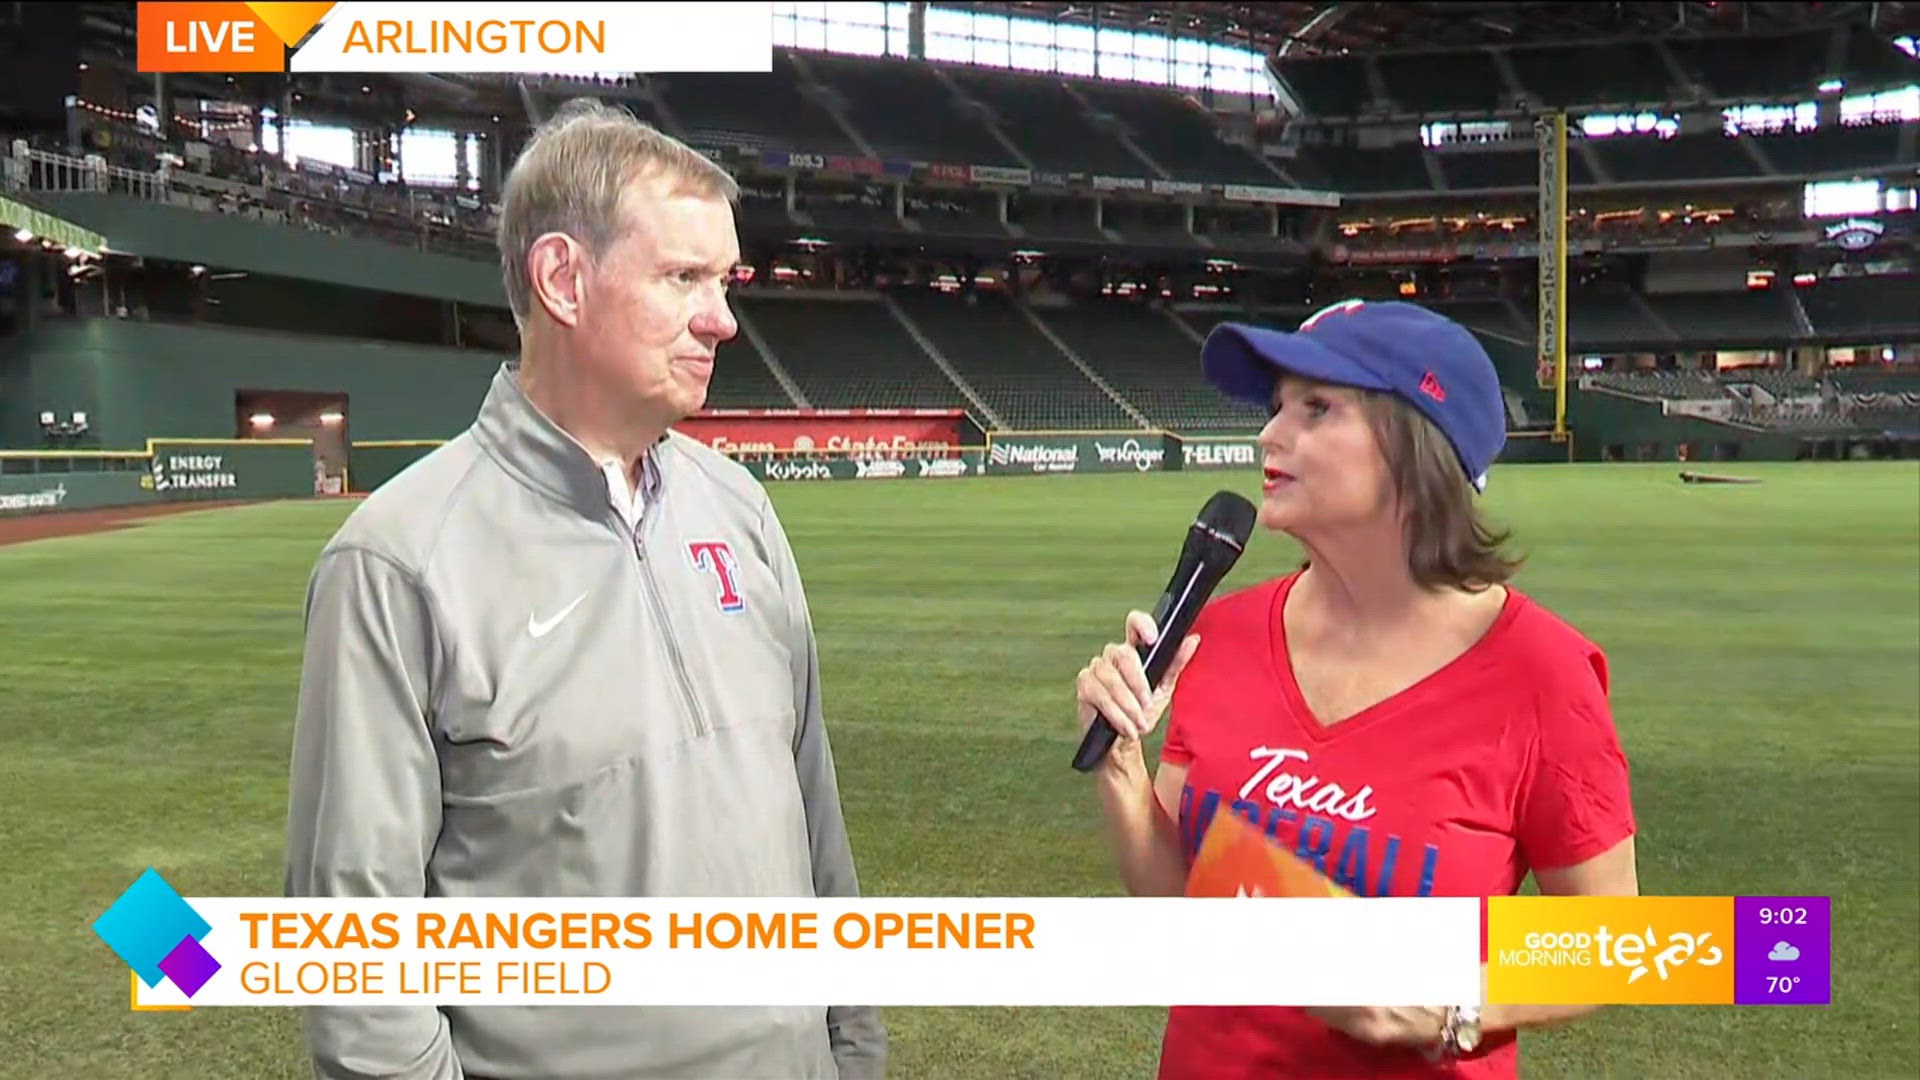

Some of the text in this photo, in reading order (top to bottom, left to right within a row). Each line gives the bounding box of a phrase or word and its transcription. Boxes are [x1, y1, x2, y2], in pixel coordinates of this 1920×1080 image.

[169, 456, 223, 470] ENERGY
[1009, 443, 1079, 465] National
[1117, 438, 1165, 471] Kroger
[171, 473, 237, 488] TRANSFER
[765, 461, 831, 479] Kubota
[682, 539, 746, 614] T
[1238, 745, 1377, 821] Texas
[1180, 784, 1439, 897] BALL
